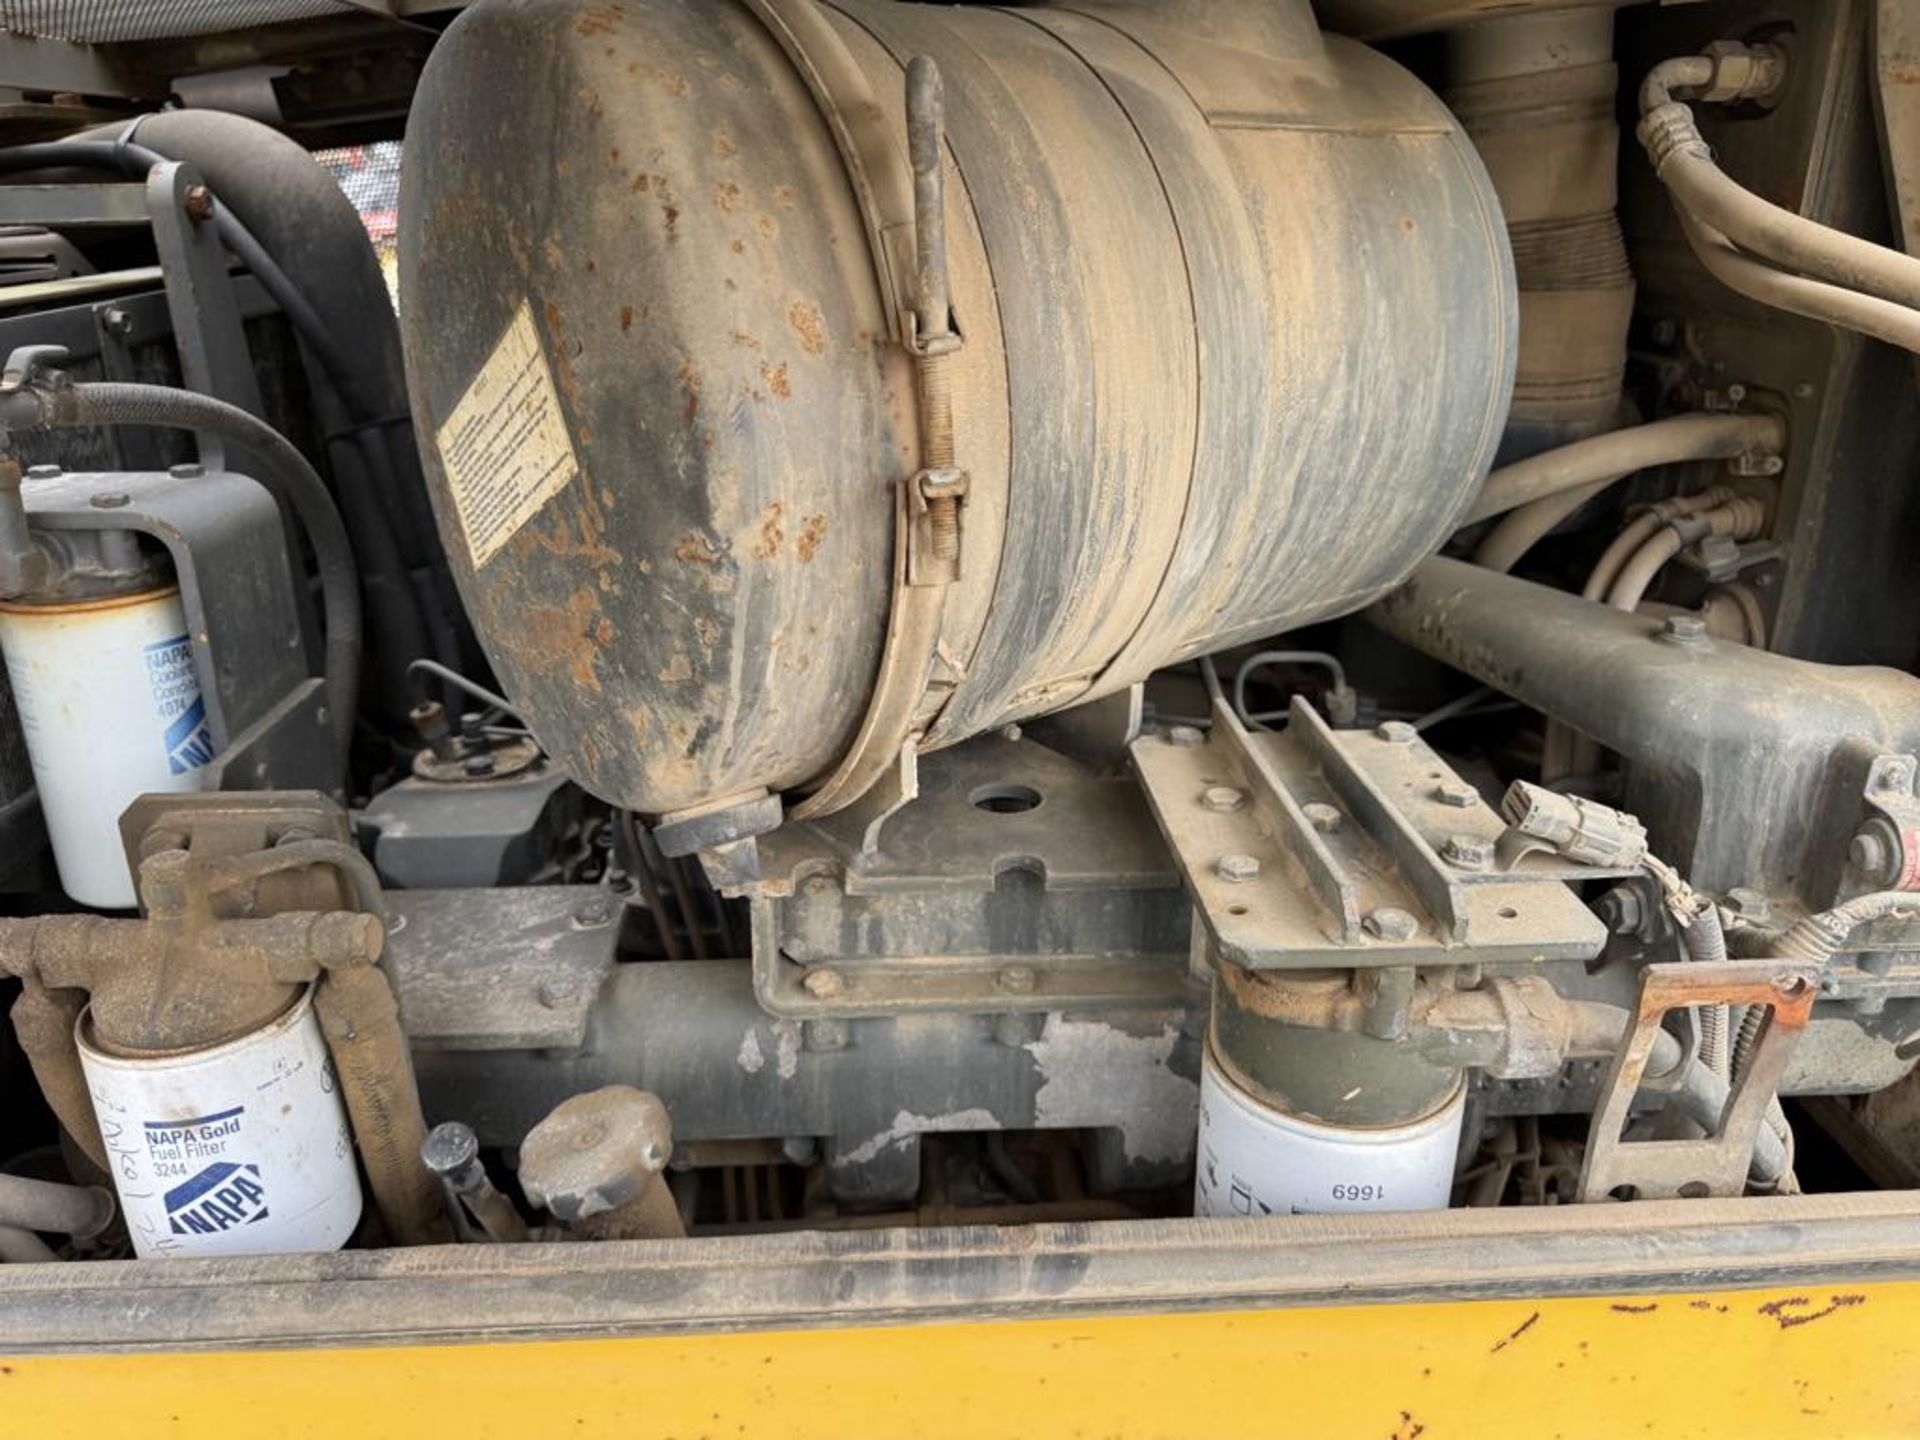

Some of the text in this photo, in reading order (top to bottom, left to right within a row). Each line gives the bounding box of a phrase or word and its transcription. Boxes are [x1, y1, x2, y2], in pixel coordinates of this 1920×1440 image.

[145, 1117, 241, 1145] NAPA Gold
[150, 1140, 227, 1160] Fuel Filter
[152, 1161, 188, 1178] 3244
[179, 1175, 265, 1235] NAPA
